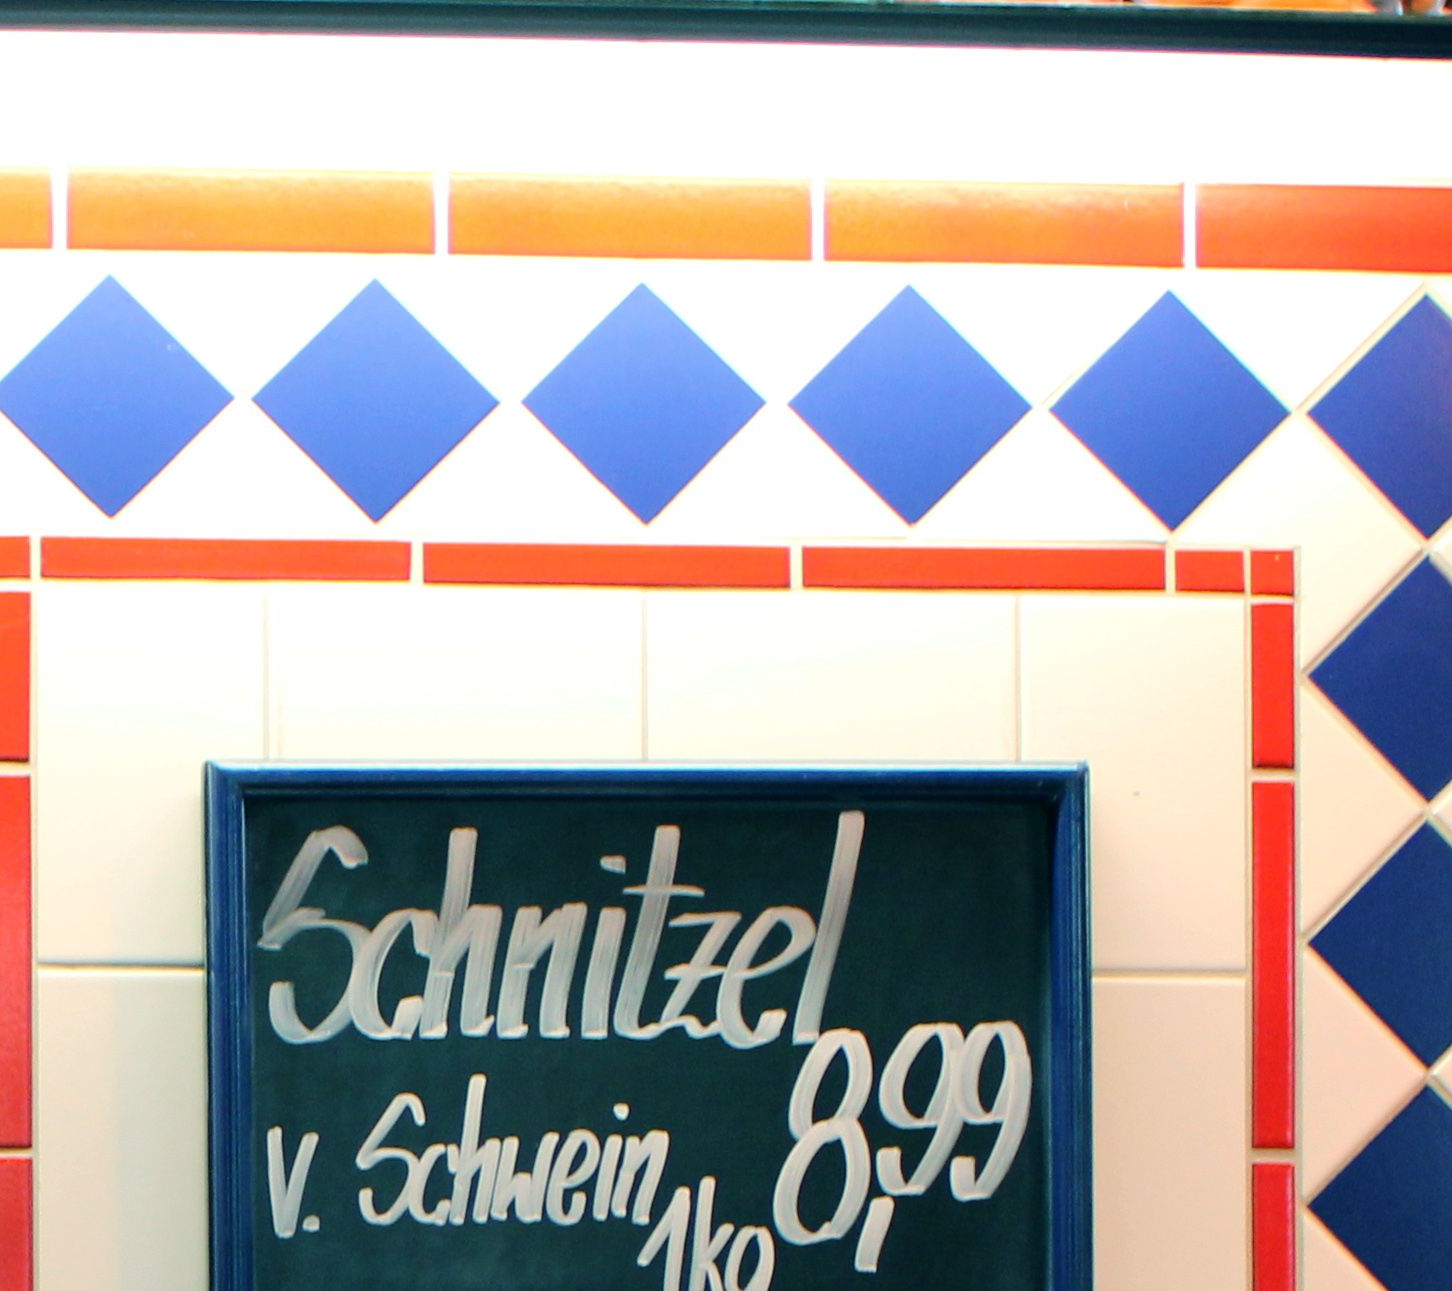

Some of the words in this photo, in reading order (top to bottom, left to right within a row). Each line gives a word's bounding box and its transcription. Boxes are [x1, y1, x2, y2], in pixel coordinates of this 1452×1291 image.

[258, 809, 866, 1046] Schnitzel
[356, 1073, 670, 1226] Schwein
[771, 1019, 1033, 1272] 8,99
